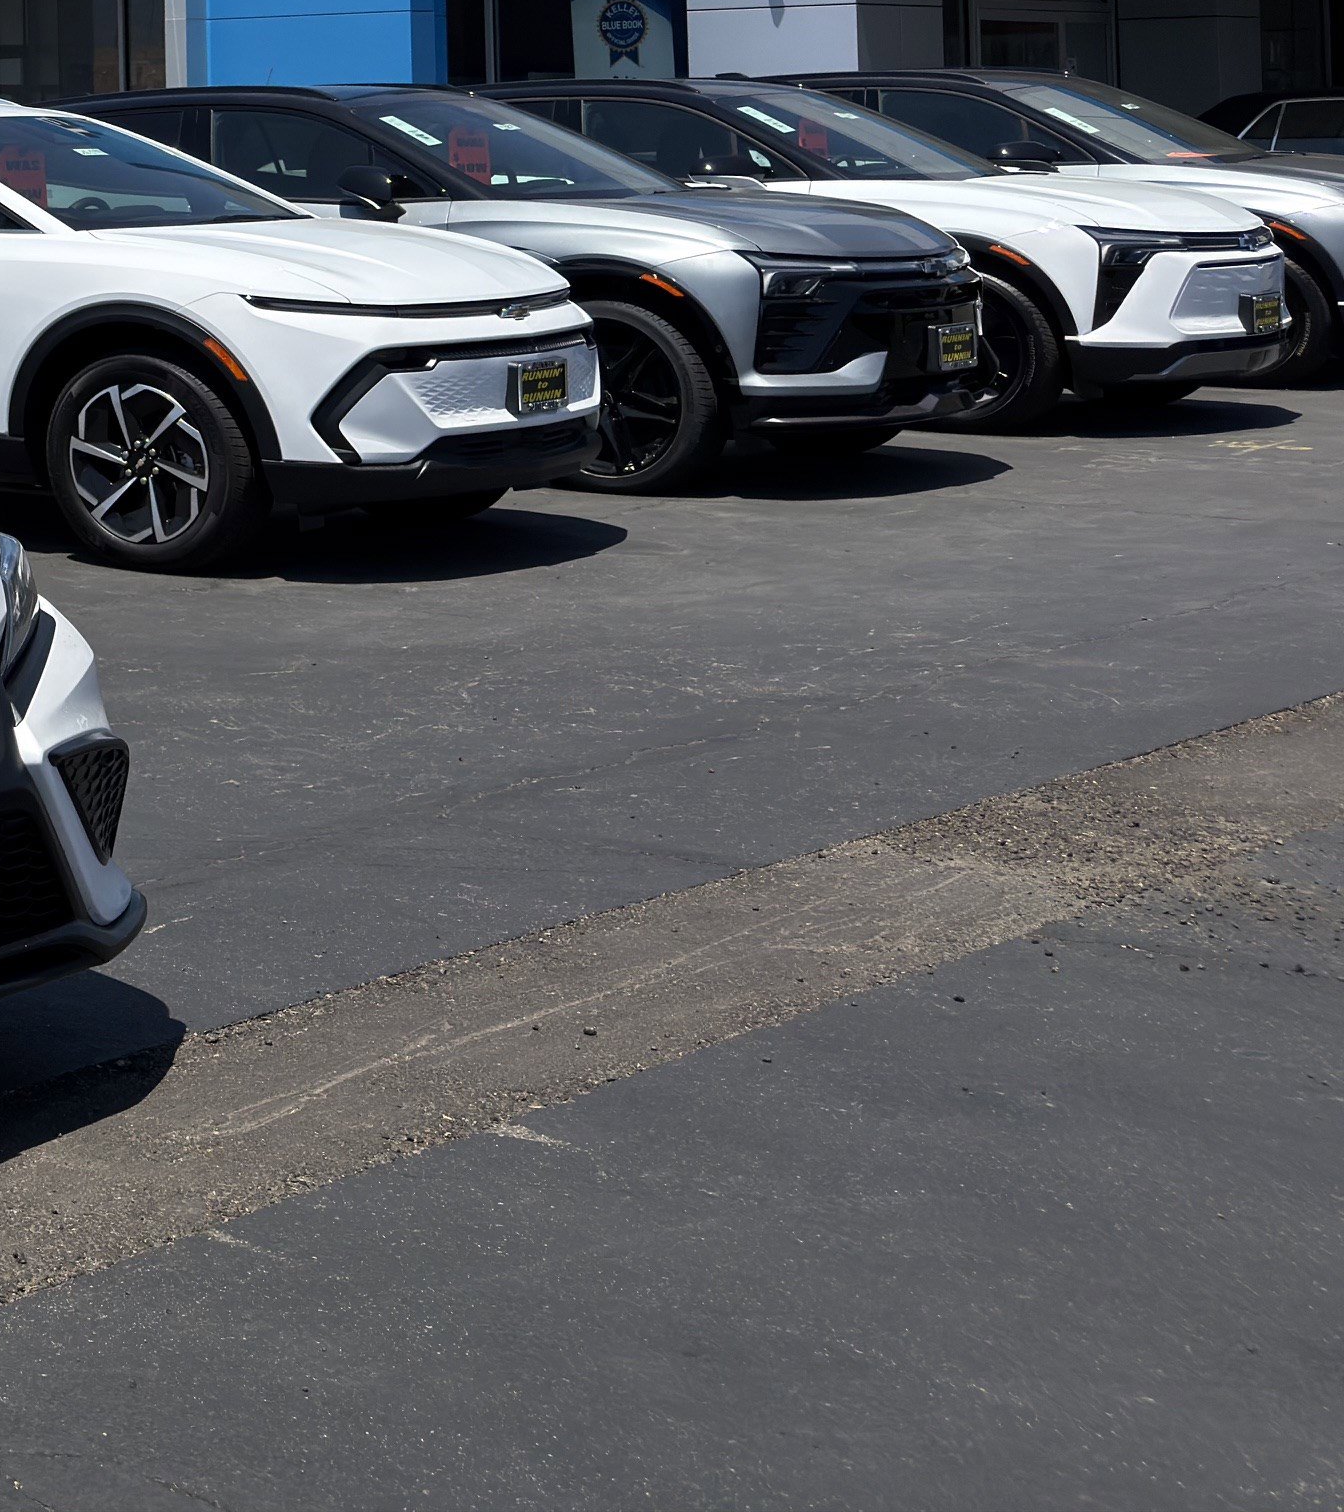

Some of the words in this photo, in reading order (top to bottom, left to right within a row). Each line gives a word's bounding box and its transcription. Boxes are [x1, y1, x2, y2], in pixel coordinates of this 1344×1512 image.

[605, 3, 640, 18] KELLEY
[601, 21, 621, 30] BLUE
[622, 20, 643, 29] BOOK
[522, 368, 563, 381] RUNNIN'
[537, 381, 548, 389] to
[523, 389, 562, 403] BUNNIN
